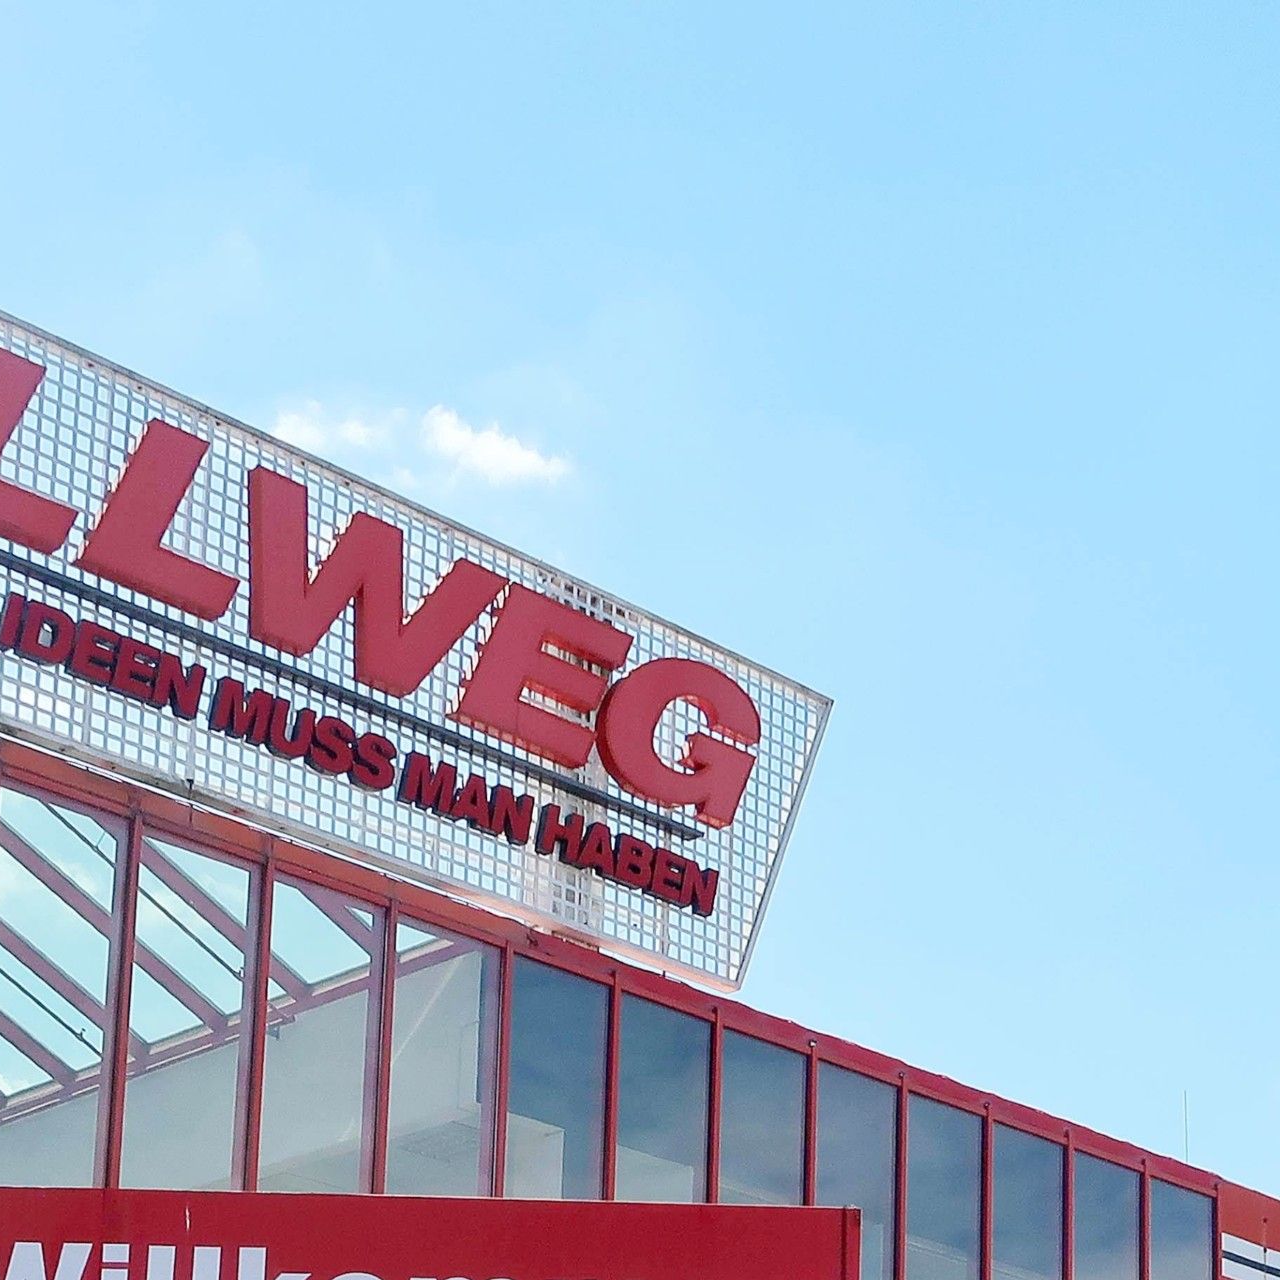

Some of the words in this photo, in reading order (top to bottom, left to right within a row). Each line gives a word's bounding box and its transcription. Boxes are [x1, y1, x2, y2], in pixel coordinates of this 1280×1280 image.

[210, 678, 397, 792] MUSS
[397, 752, 536, 846] MAN
[535, 804, 717, 917] HABEN
